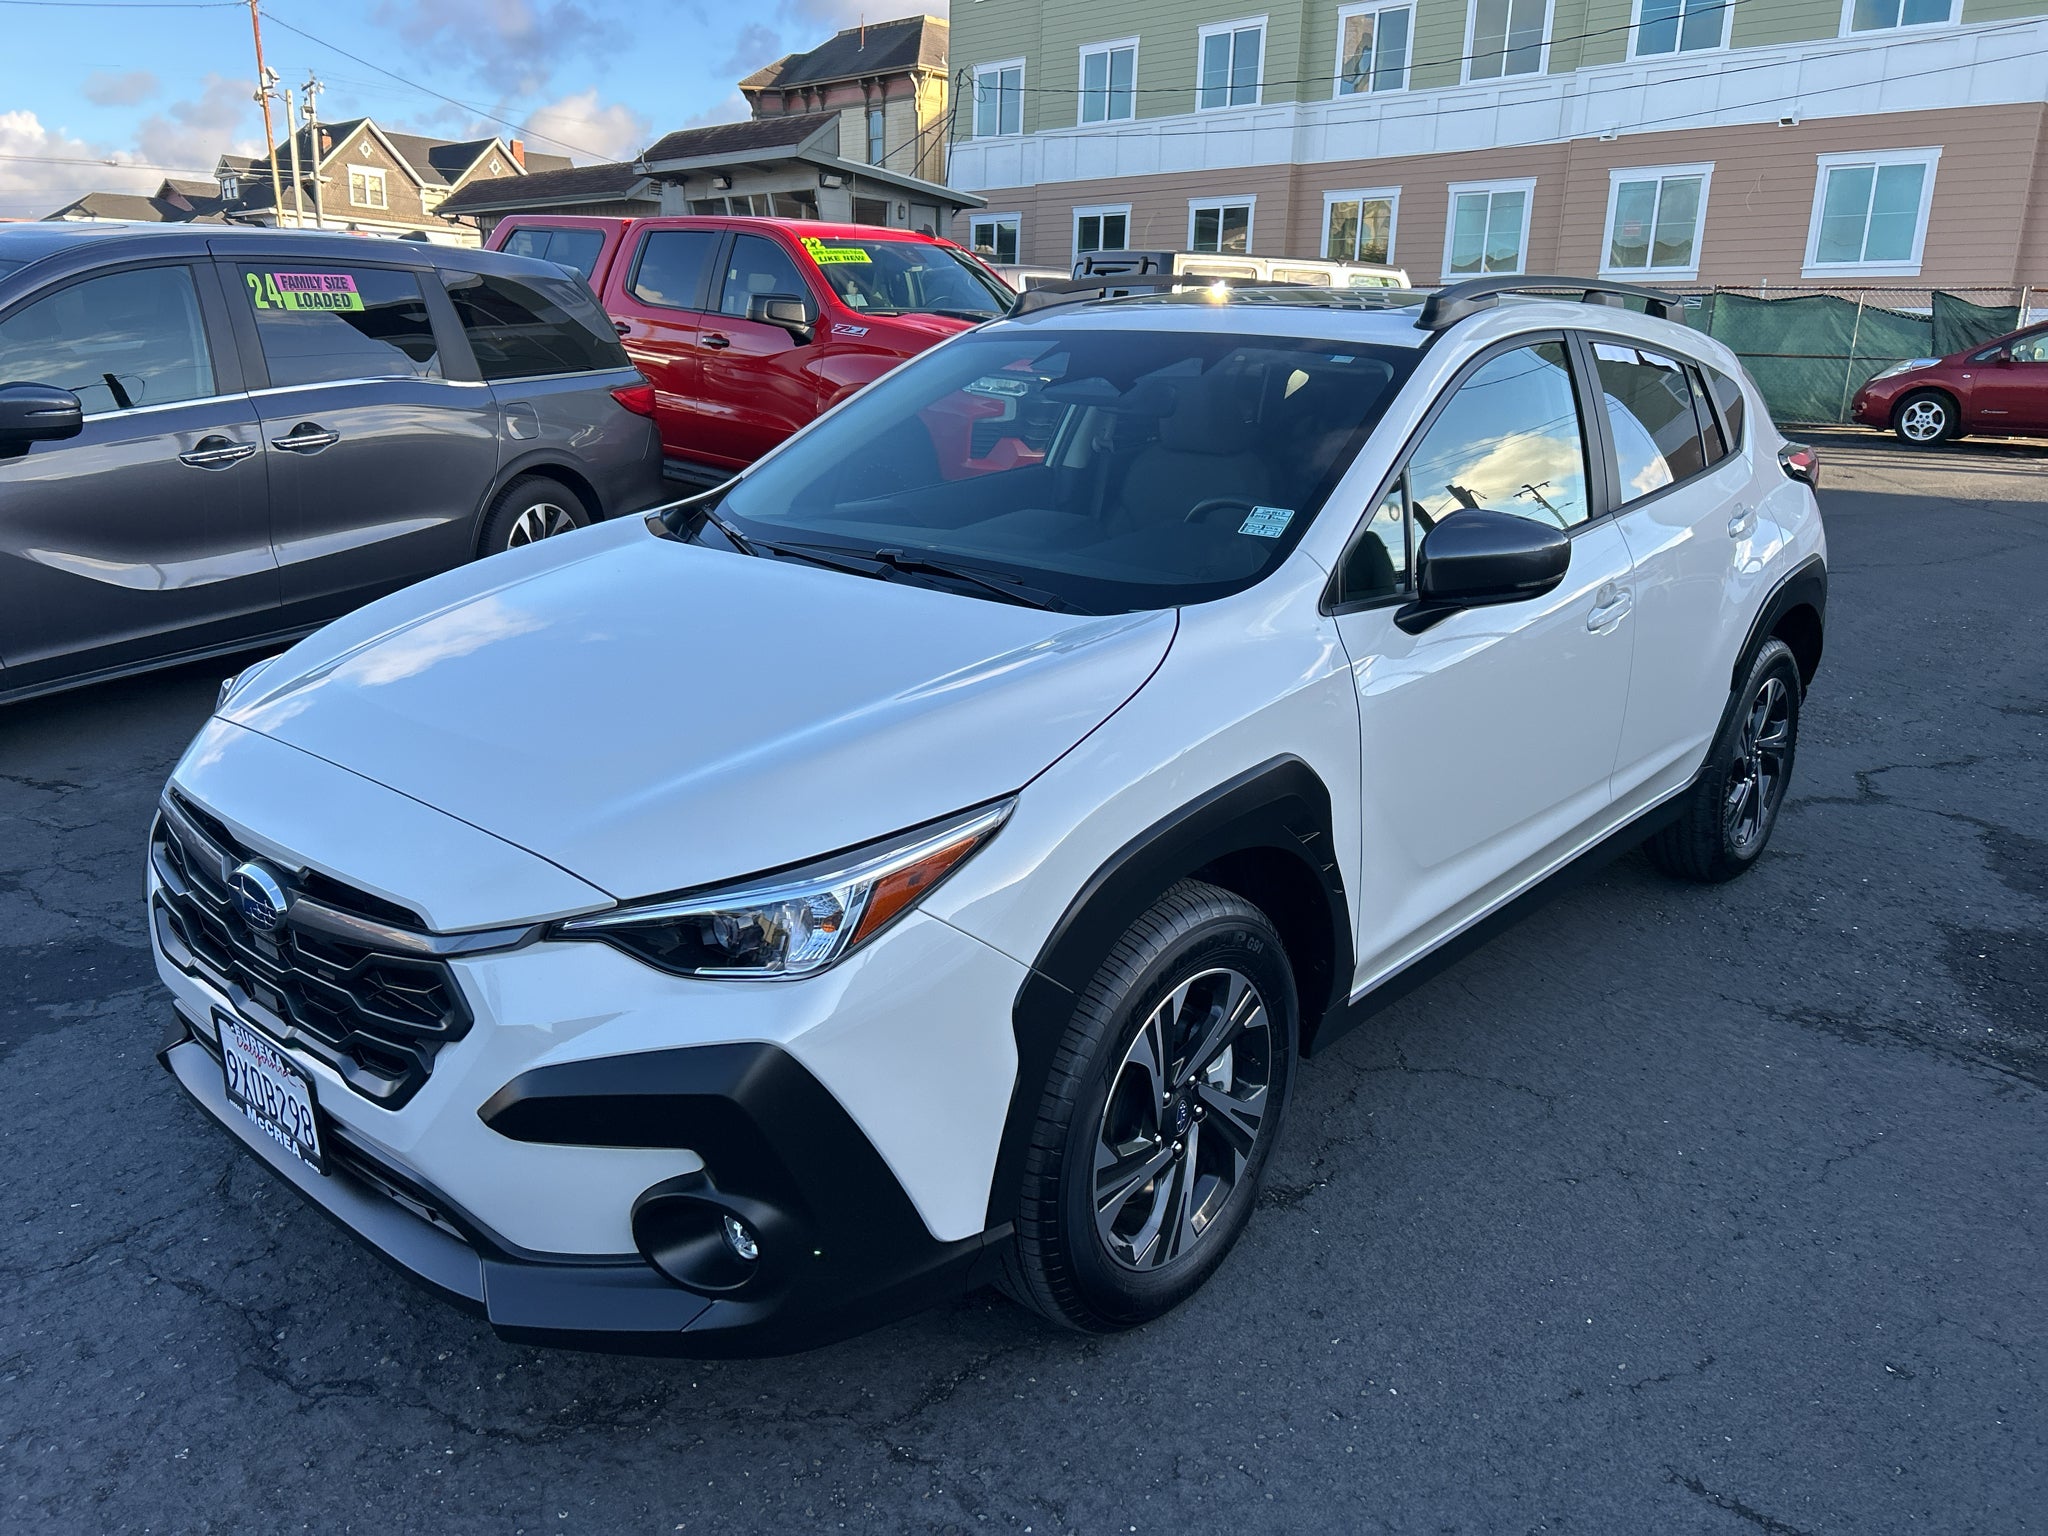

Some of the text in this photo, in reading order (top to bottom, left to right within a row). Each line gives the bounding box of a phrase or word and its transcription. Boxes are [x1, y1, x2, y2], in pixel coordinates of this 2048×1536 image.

[246, 273, 284, 309] 24
[280, 275, 350, 291] FAMILY SIZE
[295, 292, 354, 309] LOADED
[233, 1022, 286, 1070] EUREKA
[246, 1104, 301, 1159] McCREA
